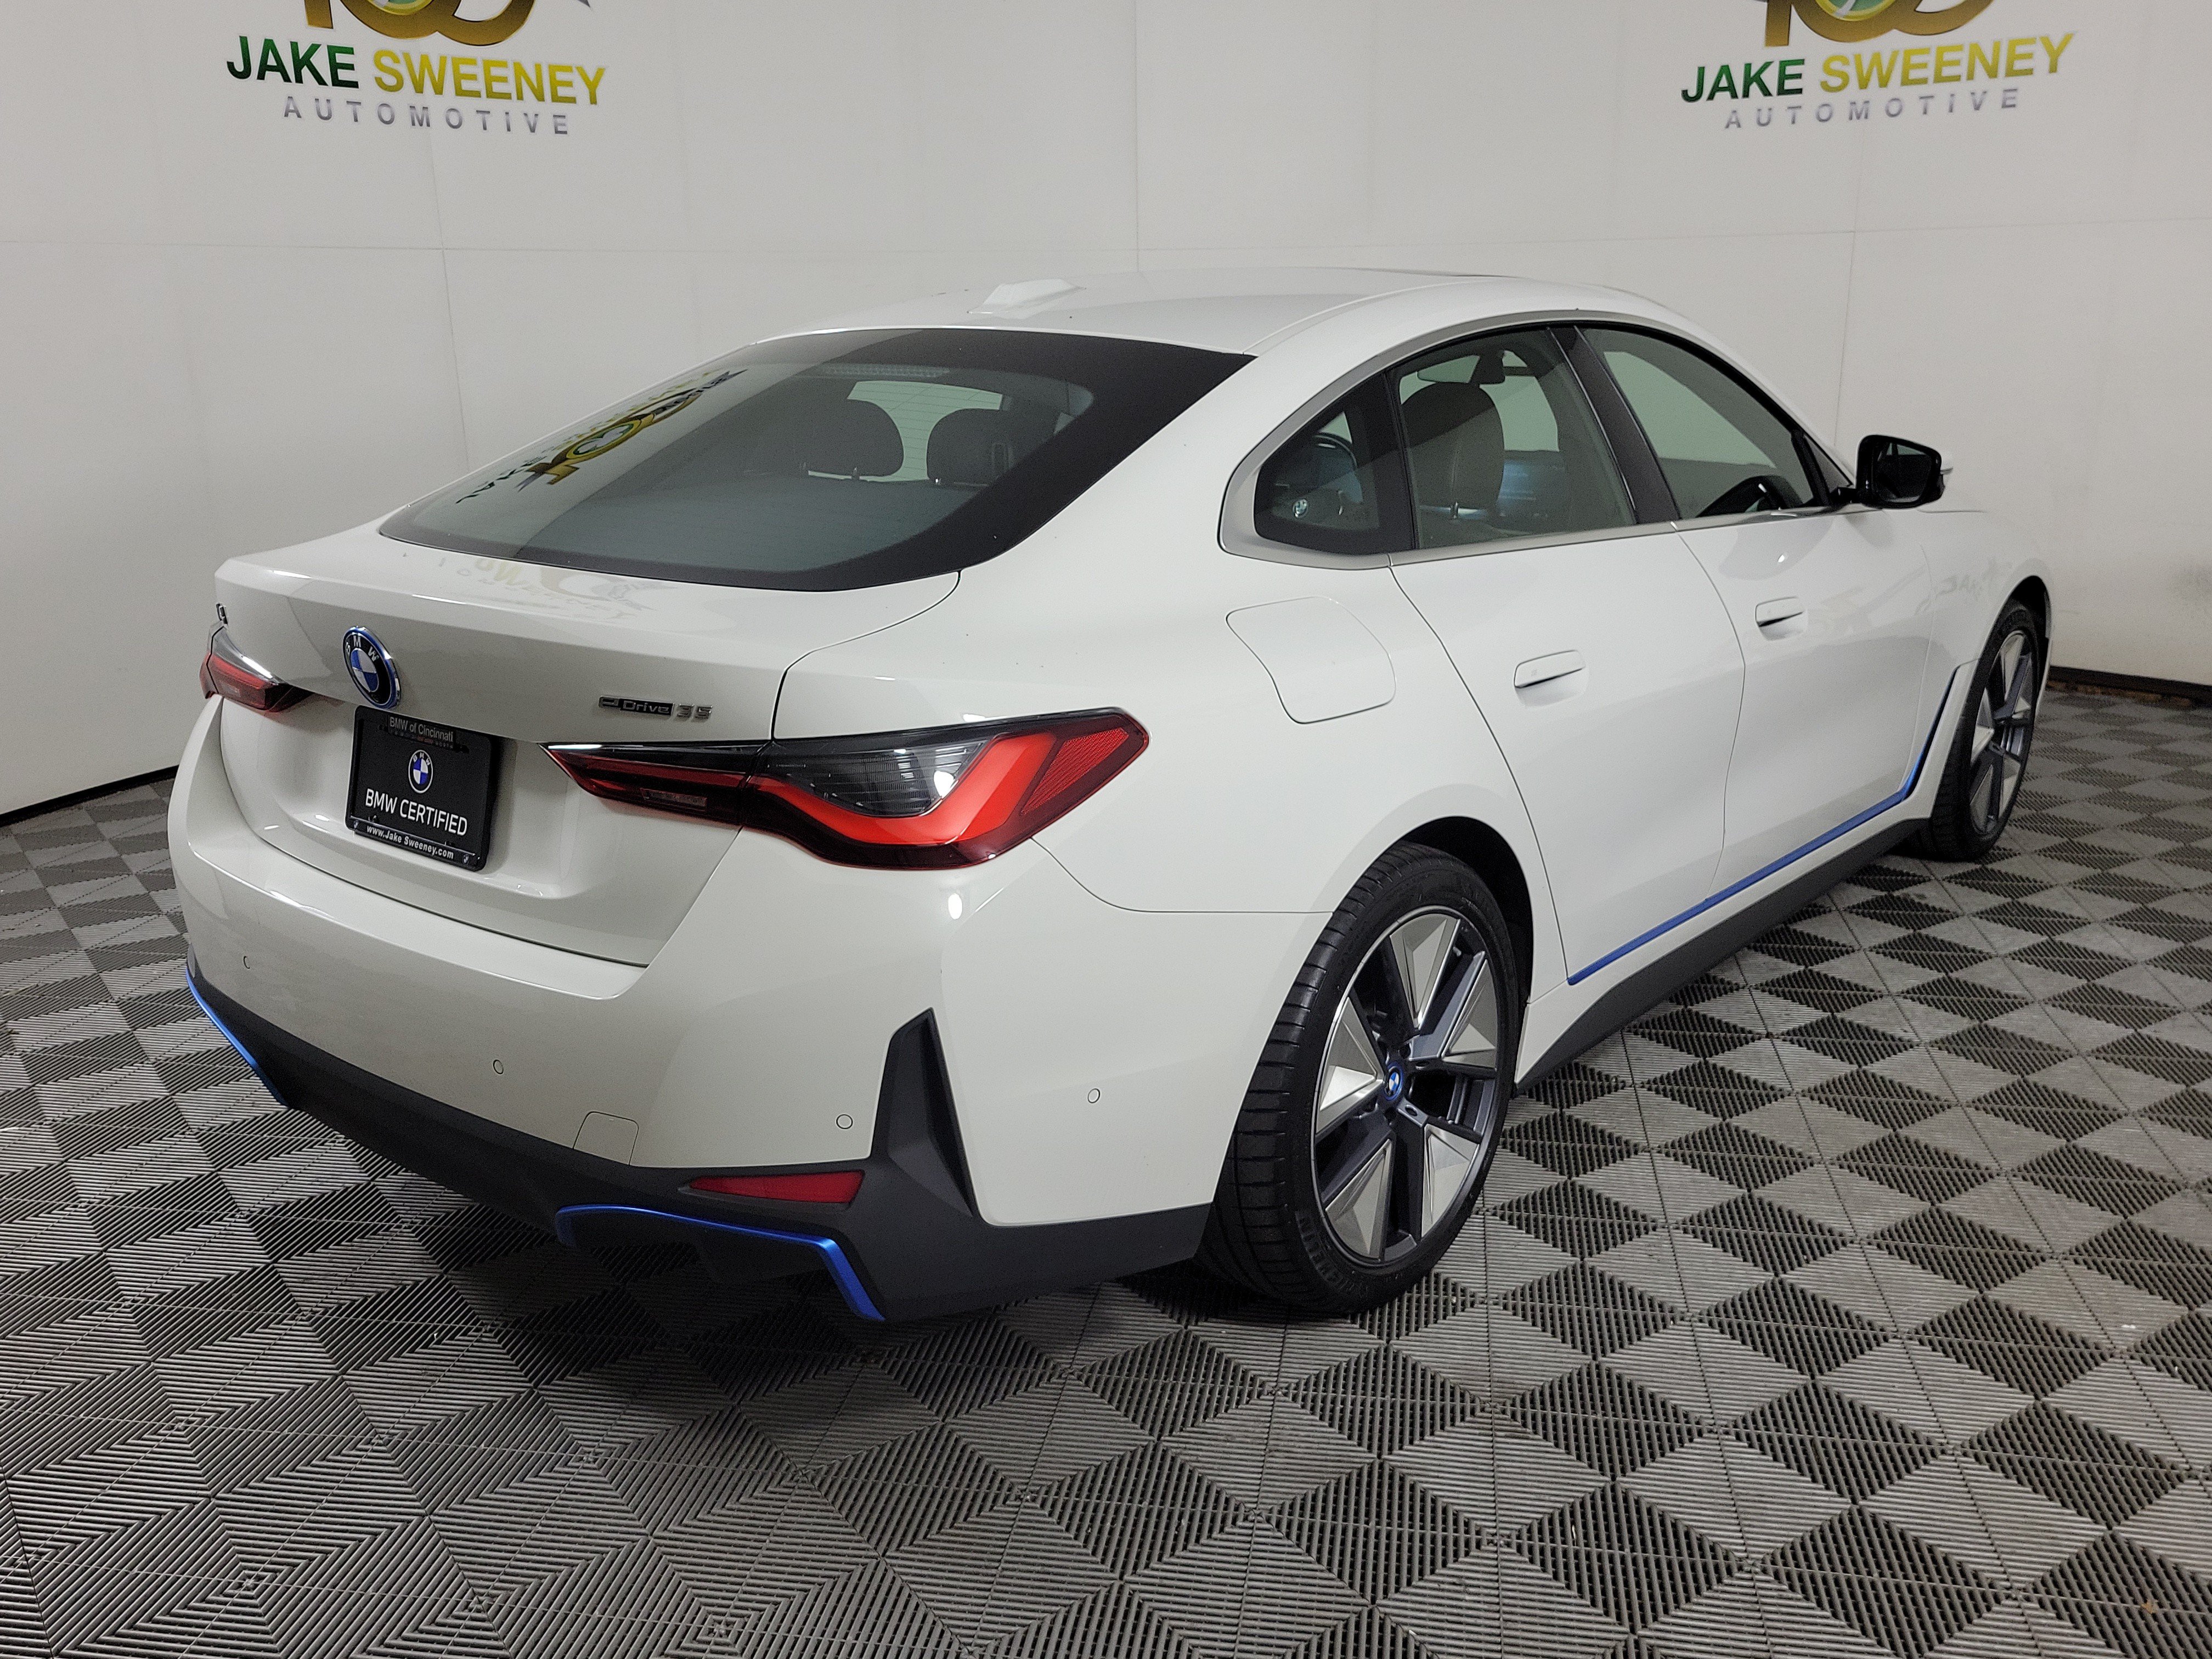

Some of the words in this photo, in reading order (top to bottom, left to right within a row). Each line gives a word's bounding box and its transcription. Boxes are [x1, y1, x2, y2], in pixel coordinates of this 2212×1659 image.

[227, 35, 359, 89] JAKE
[373, 49, 606, 105] SWEENEY
[1681, 59, 1805, 103] JAKE
[1820, 33, 2074, 93] SWEENEY
[283, 97, 568, 134] AUTOMOTIVE
[1725, 89, 2019, 129] AUTOMOTIVE
[600, 696, 671, 715] eDrive
[677, 703, 713, 718] 35
[390, 716, 408, 731] BMW
[409, 722, 417, 734] of
[418, 724, 454, 742] Cincinnati
[365, 788, 398, 814] BMW
[399, 799, 467, 836] CERTIFIED
[366, 825, 402, 843] www.Jake
[404, 836, 454, 859] Sweeney.com
